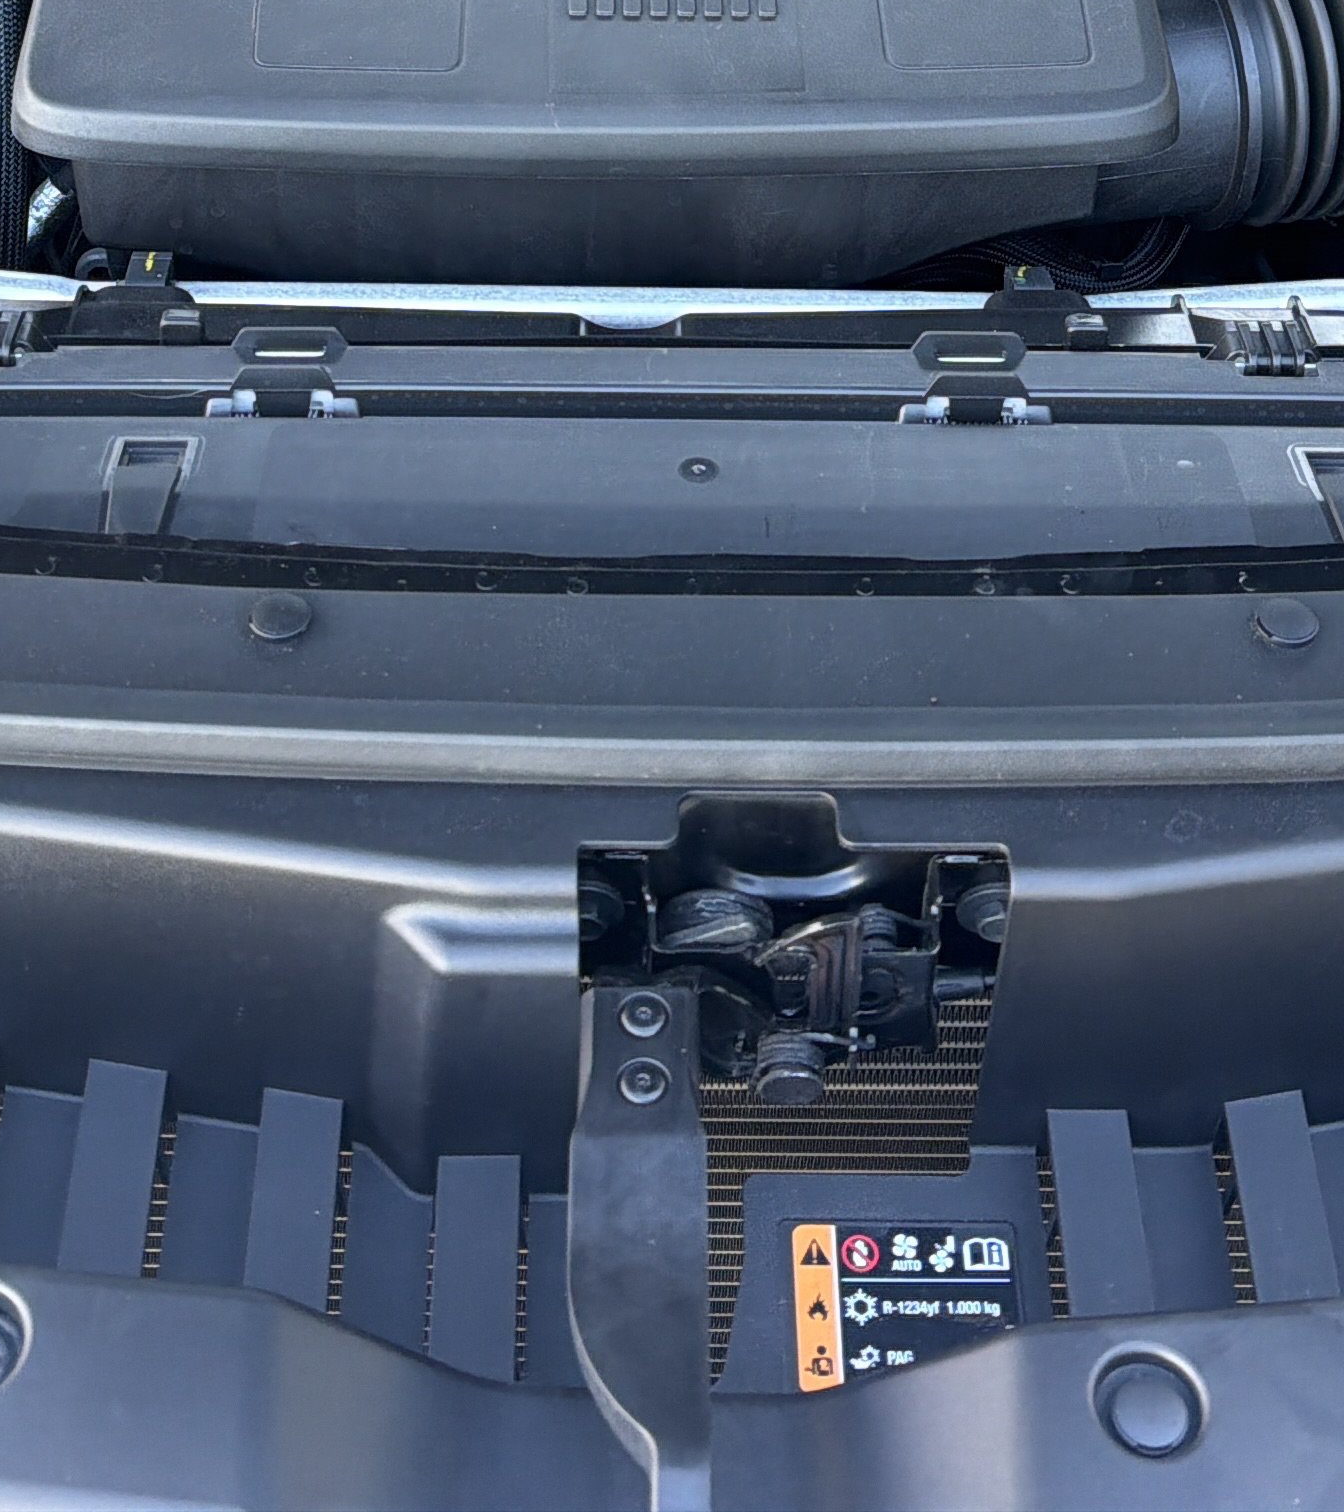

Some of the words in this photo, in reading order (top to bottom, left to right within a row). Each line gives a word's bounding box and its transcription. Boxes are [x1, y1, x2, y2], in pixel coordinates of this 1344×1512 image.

[891, 1259, 922, 1272] AUTO
[882, 1300, 940, 1317] R-1234yf
[946, 1300, 981, 1315] 1.000
[983, 1300, 1001, 1317] kg
